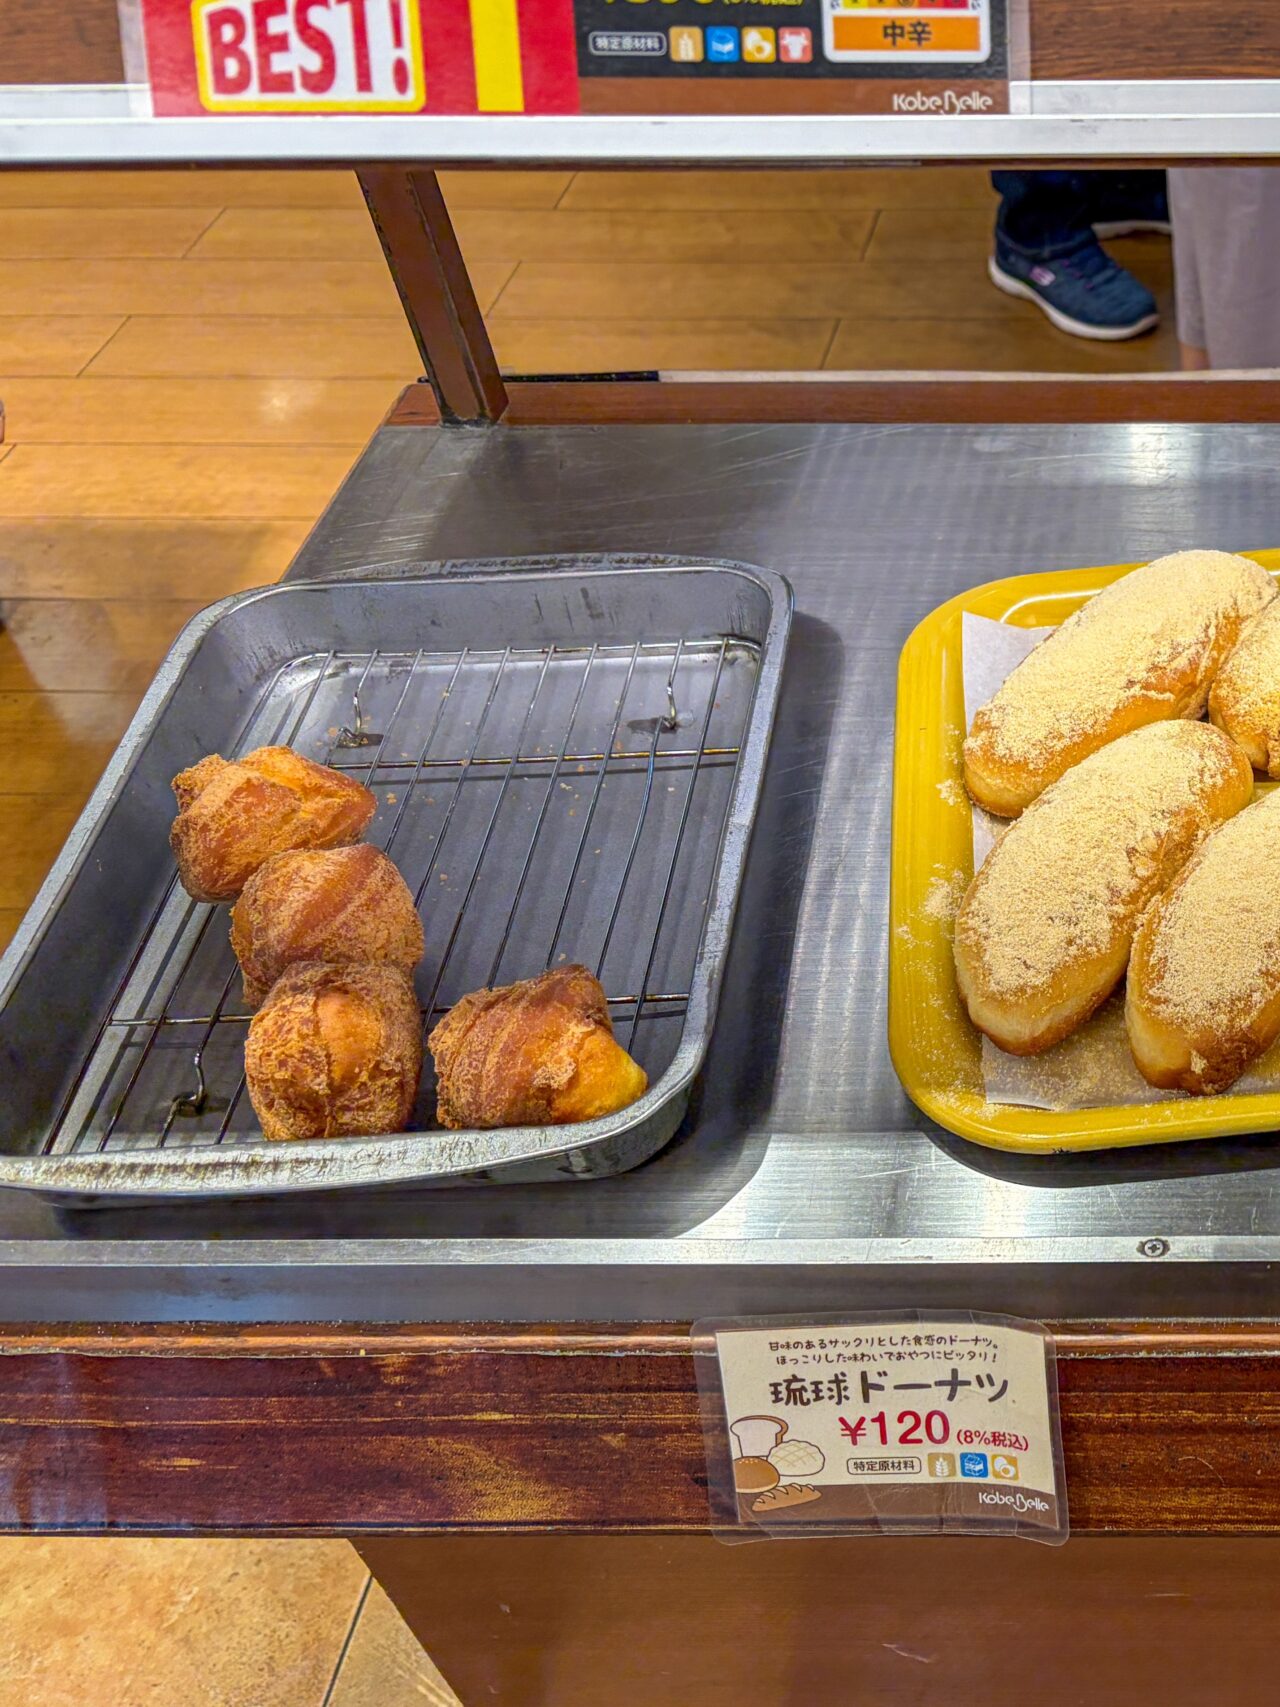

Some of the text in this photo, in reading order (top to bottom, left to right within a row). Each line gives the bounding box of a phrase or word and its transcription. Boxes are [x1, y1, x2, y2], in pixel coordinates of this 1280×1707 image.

[205, 0, 410, 97] BEST!
[595, 37, 660, 51] 特定原材料
[882, 20, 932, 47] 中辛
[769, 1368, 1008, 1406] 琉球ドーナツ
[838, 1410, 1029, 1451] ¥120 (8%税込)
[853, 1459, 915, 1473] 特定原材料
